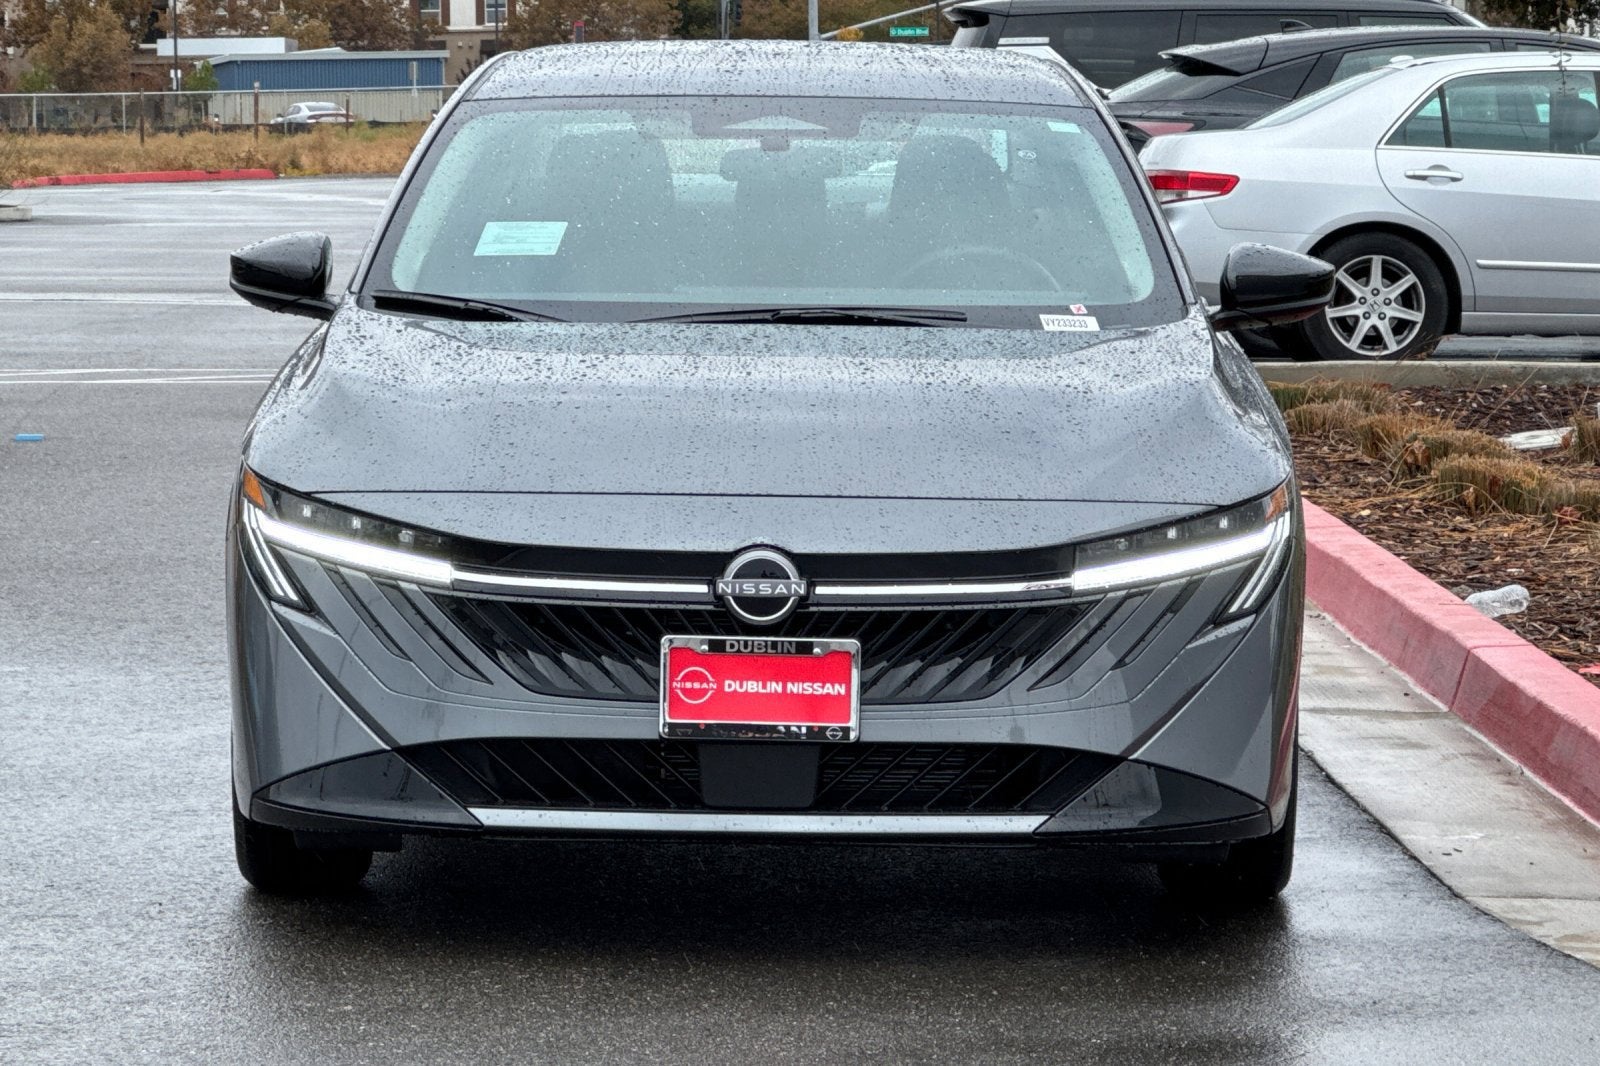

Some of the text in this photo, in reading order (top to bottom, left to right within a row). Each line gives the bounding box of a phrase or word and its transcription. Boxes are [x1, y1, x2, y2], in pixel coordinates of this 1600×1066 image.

[1043, 317, 1088, 328] VY233233
[718, 583, 805, 594] NISSAN
[725, 640, 796, 653] DUBLIN
[724, 680, 846, 695] DUBLIN NISSAN
